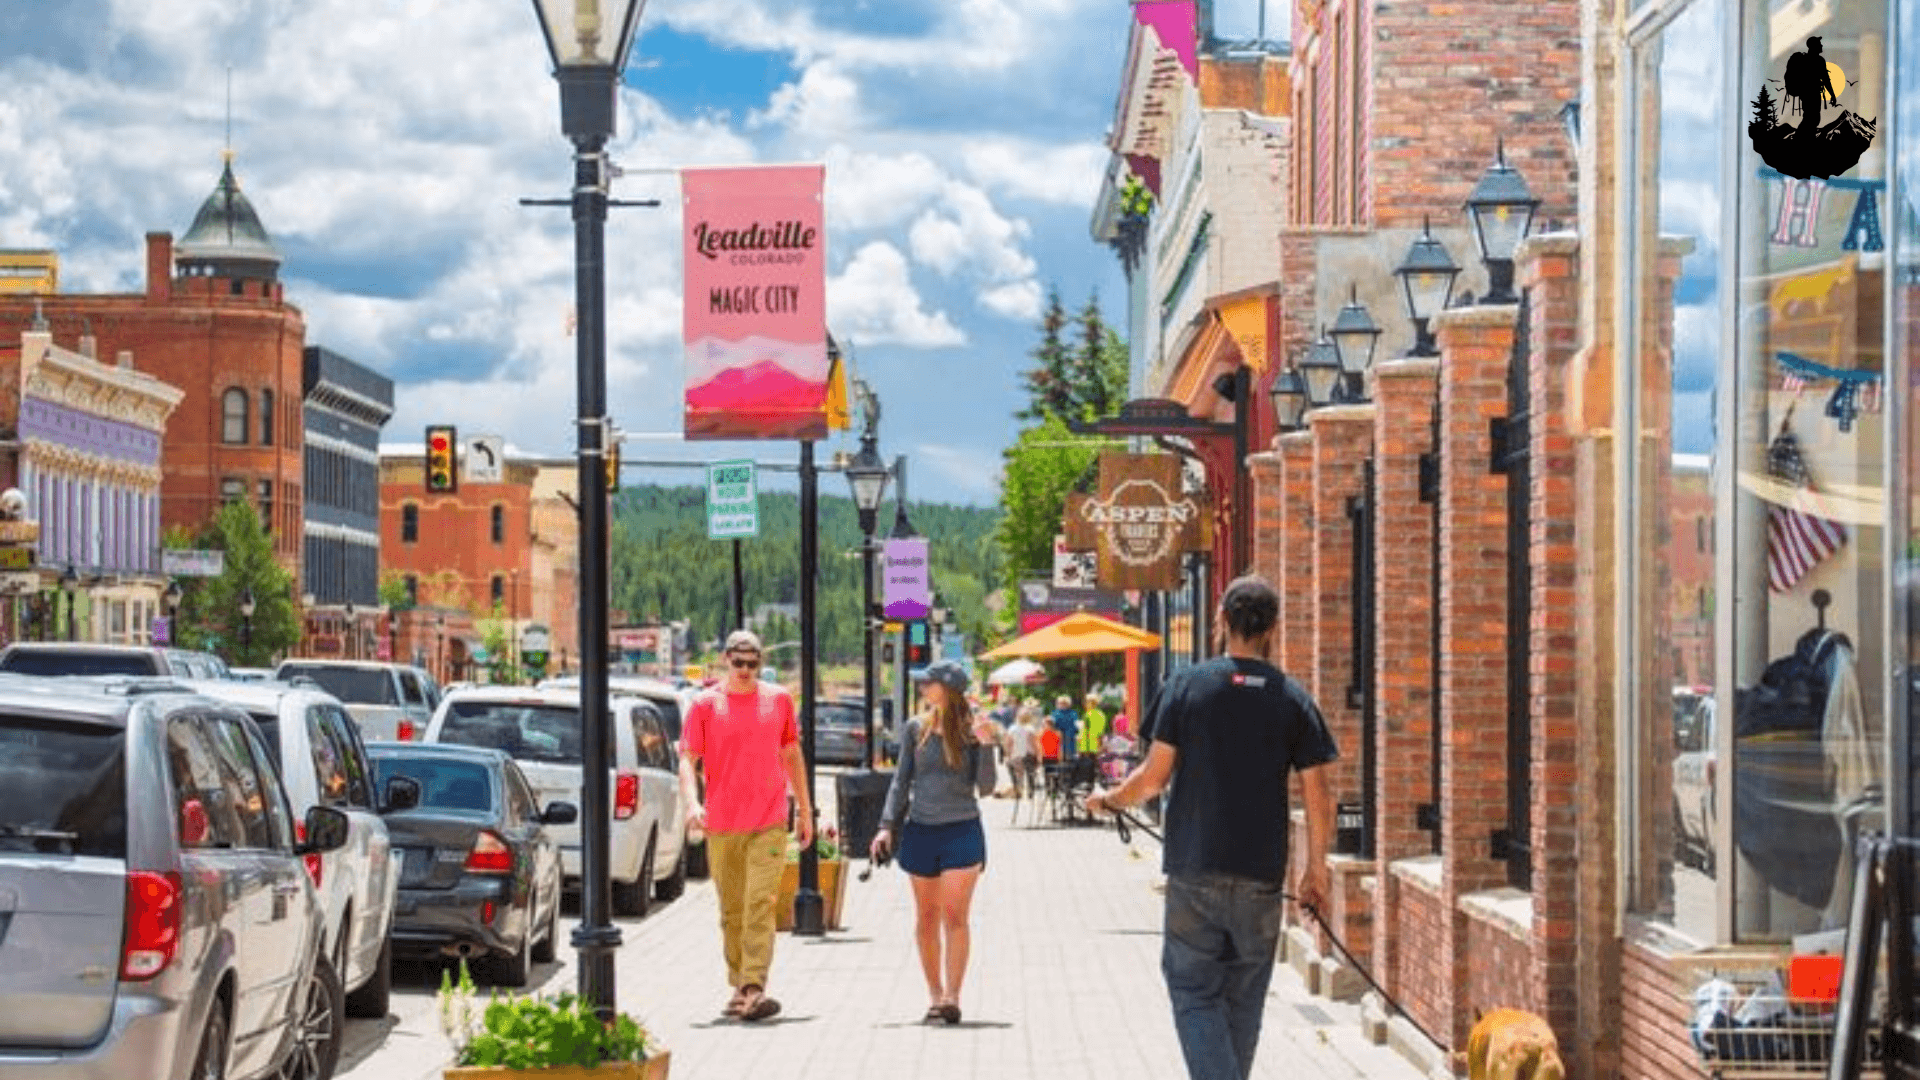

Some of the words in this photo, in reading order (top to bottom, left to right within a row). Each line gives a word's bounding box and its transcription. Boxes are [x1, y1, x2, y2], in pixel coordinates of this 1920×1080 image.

[694, 221, 815, 260] Leadville
[730, 253, 804, 266] COLORADO
[709, 286, 759, 314] MAGIC
[765, 285, 798, 314] CITY
[1086, 505, 1189, 523] ASPEN
